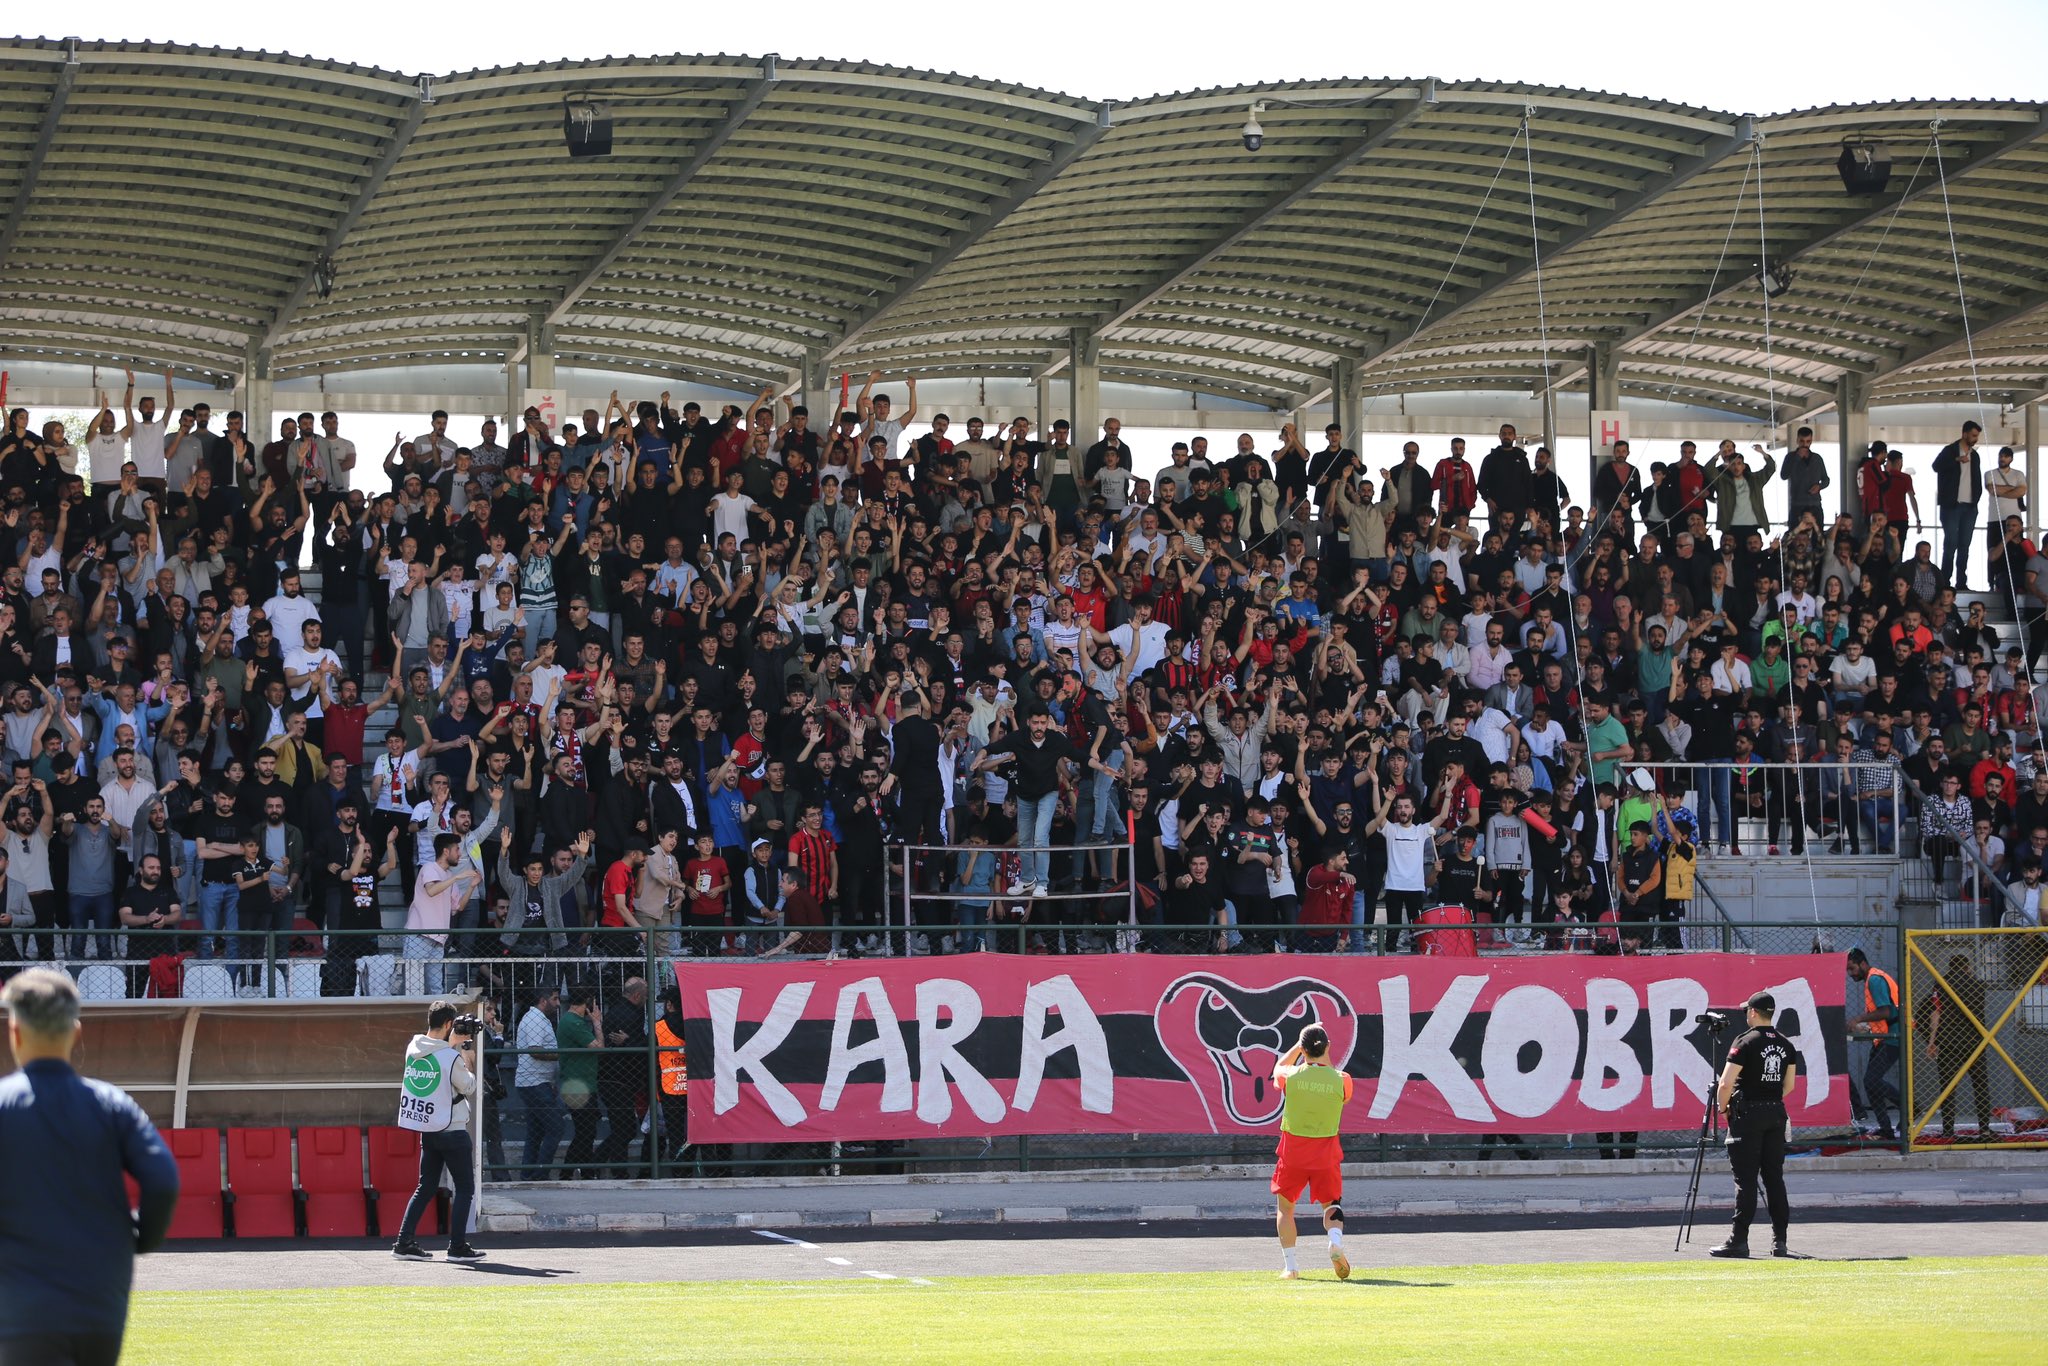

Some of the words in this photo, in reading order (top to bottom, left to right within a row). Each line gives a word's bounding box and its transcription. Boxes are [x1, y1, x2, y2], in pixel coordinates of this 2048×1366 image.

[1602, 420, 1620, 446] H
[706, 973, 1115, 1128] KARA
[1367, 973, 1831, 1123] KOBRA
[1760, 1045, 1776, 1059] ÖZEL
[1776, 1045, 1787, 1059] TİM
[1761, 1073, 1781, 1082] POLİS
[1296, 1080, 1309, 1090] VAN
[1310, 1082, 1326, 1093] SPOR
[401, 1096, 435, 1115] 0156
[401, 1111, 430, 1124] PRESS
